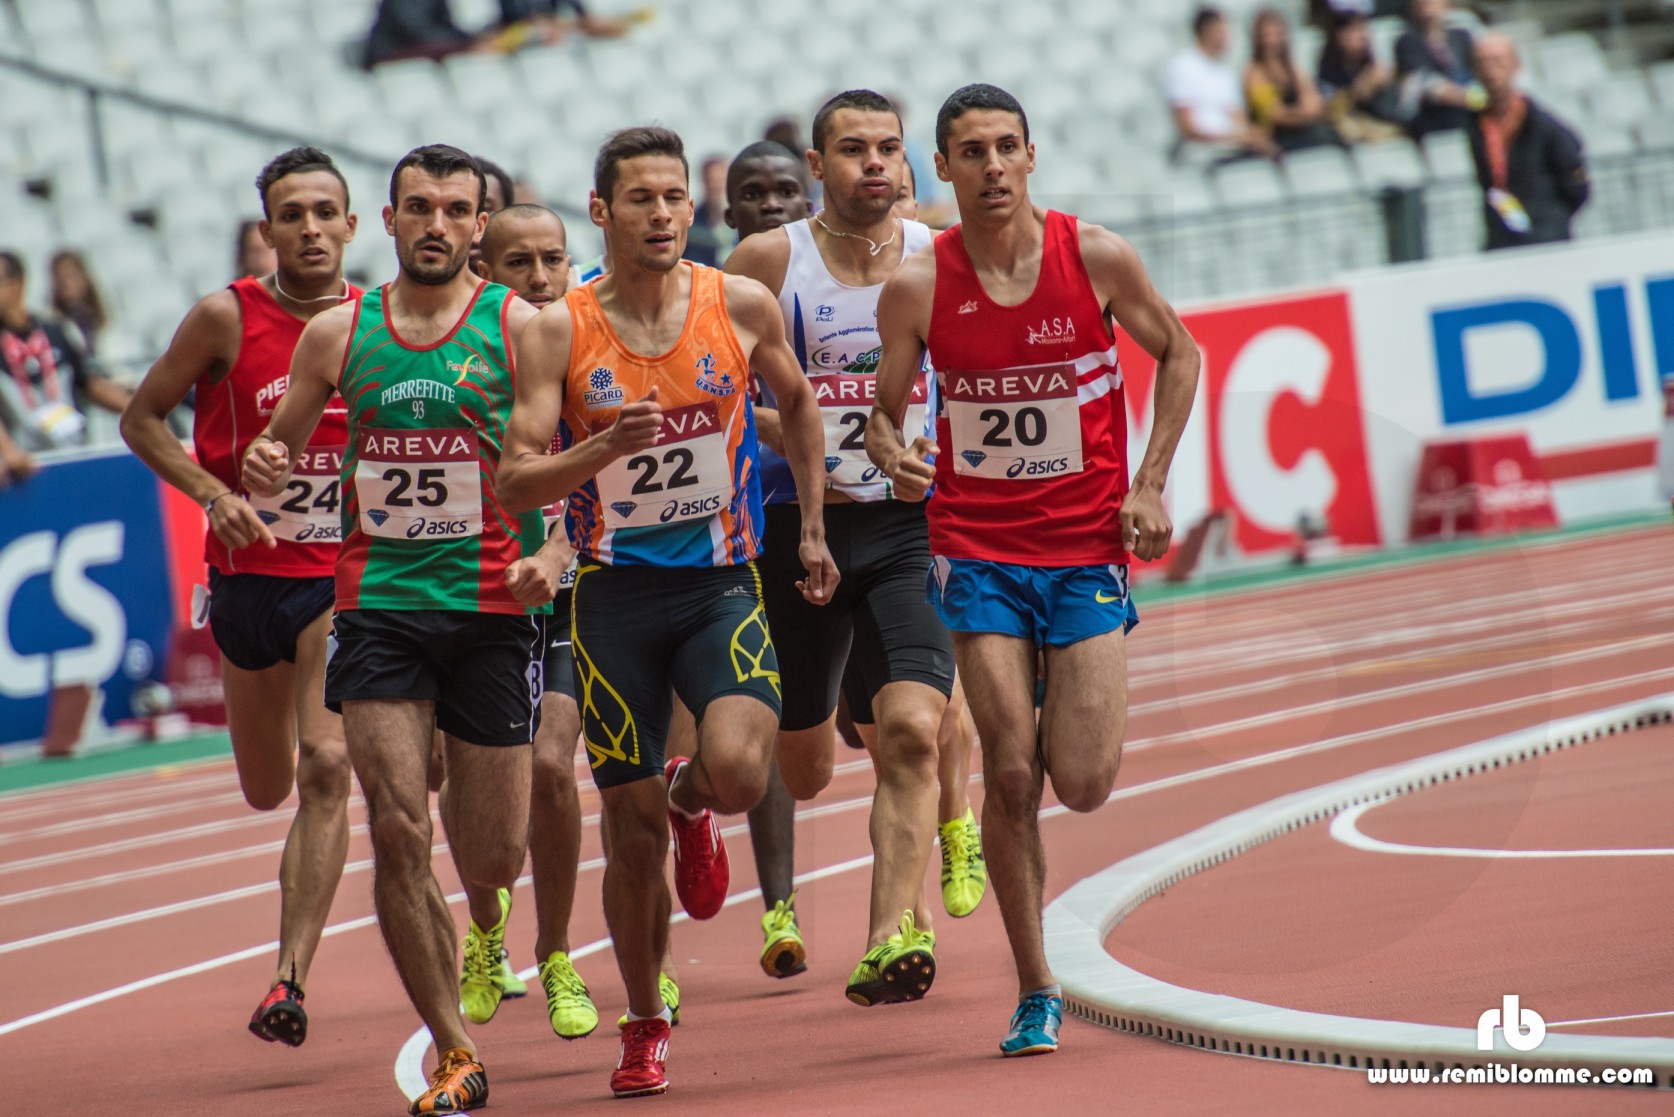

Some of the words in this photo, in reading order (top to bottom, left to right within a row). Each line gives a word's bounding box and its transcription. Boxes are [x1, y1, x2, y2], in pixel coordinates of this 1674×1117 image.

[1430, 276, 1674, 425] DI
[381, 379, 456, 406] PIERREFITTE
[954, 372, 1069, 396] AREVA
[412, 400, 425, 420] 93
[838, 411, 868, 451] 2
[979, 406, 1048, 447] 20
[365, 435, 471, 455] AREVA
[627, 447, 700, 496] 22
[1026, 457, 1069, 476] asics
[280, 480, 341, 514] 24
[382, 468, 449, 507] 25
[679, 495, 721, 516] asics
[426, 519, 468, 535] asics
